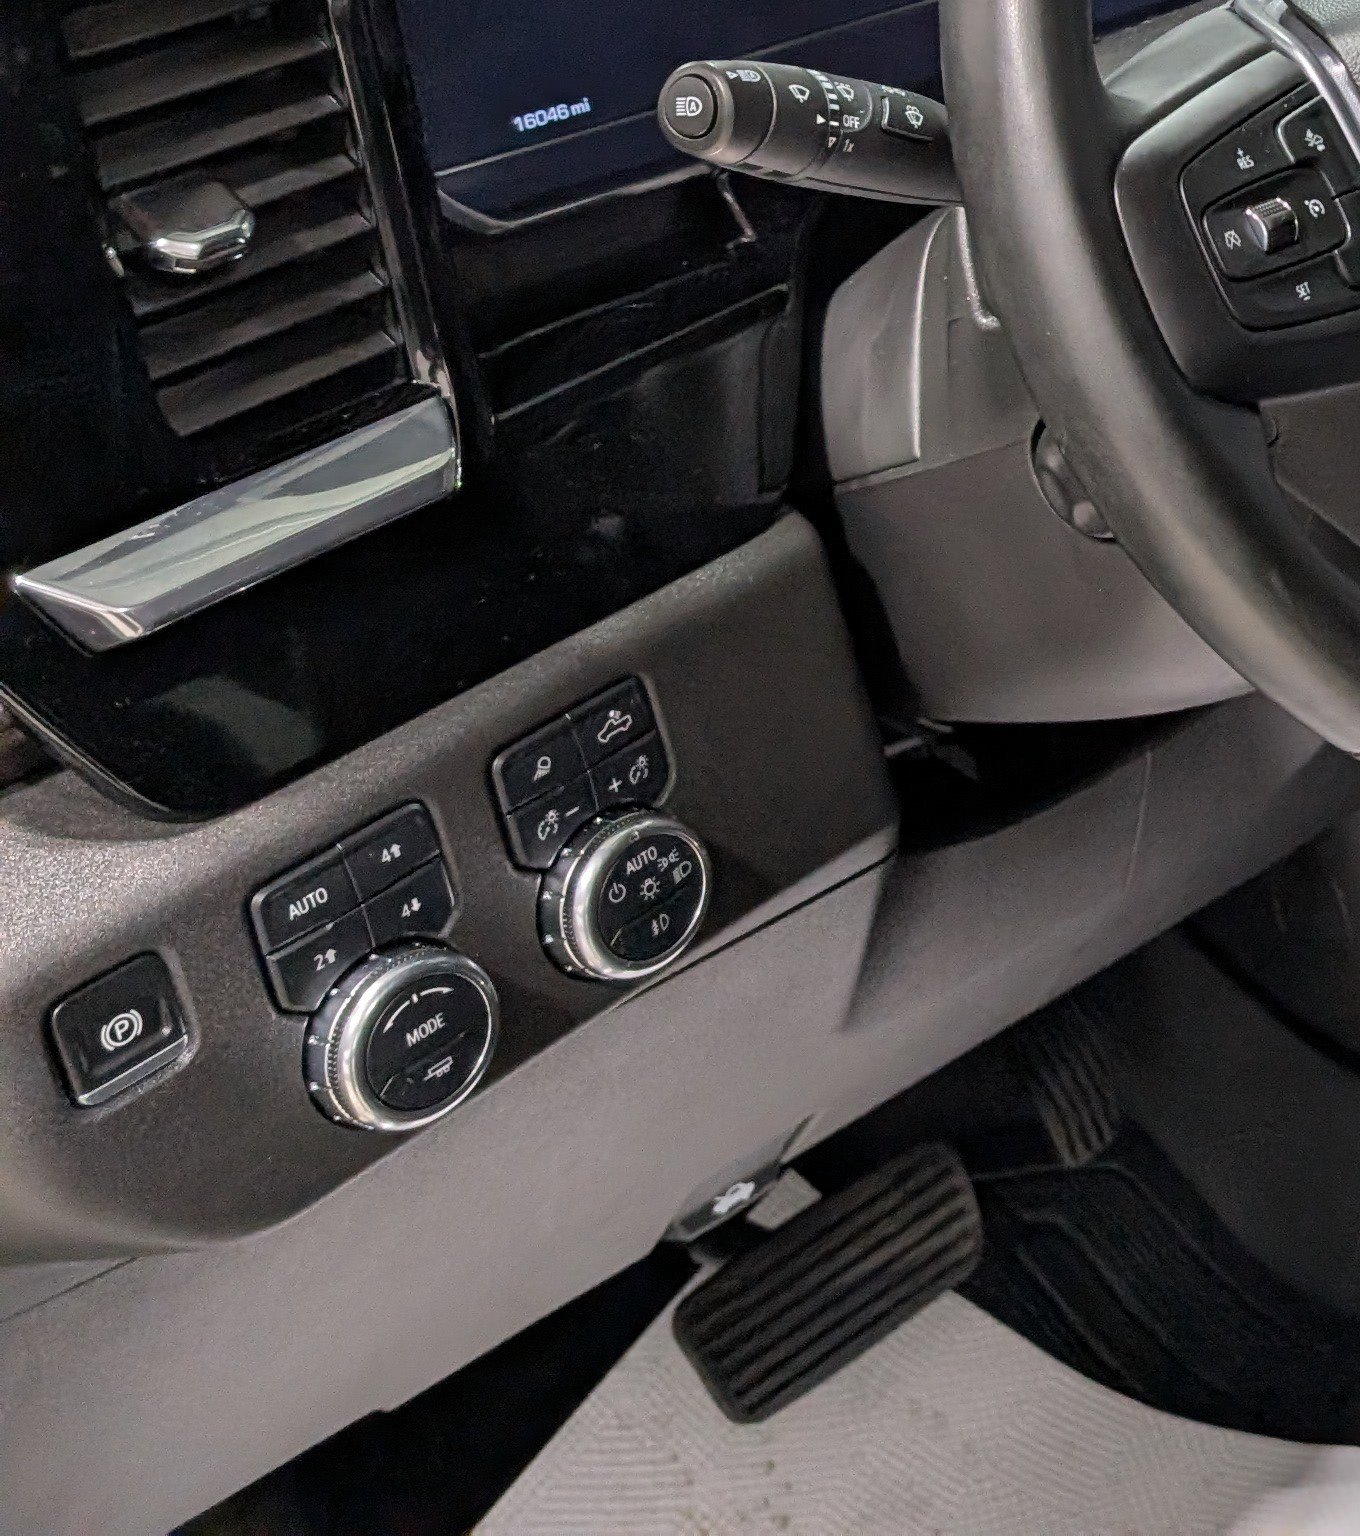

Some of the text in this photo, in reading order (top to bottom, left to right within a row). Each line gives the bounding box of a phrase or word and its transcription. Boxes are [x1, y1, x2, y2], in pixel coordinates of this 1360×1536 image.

[513, 97, 591, 132] 16046 mi
[842, 114, 860, 128] OFF
[1236, 155, 1255, 170] RES
[1295, 281, 1311, 297] SET
[626, 845, 658, 876] AUTO
[288, 887, 328, 921] AUTO
[405, 1012, 445, 1047] MODE
